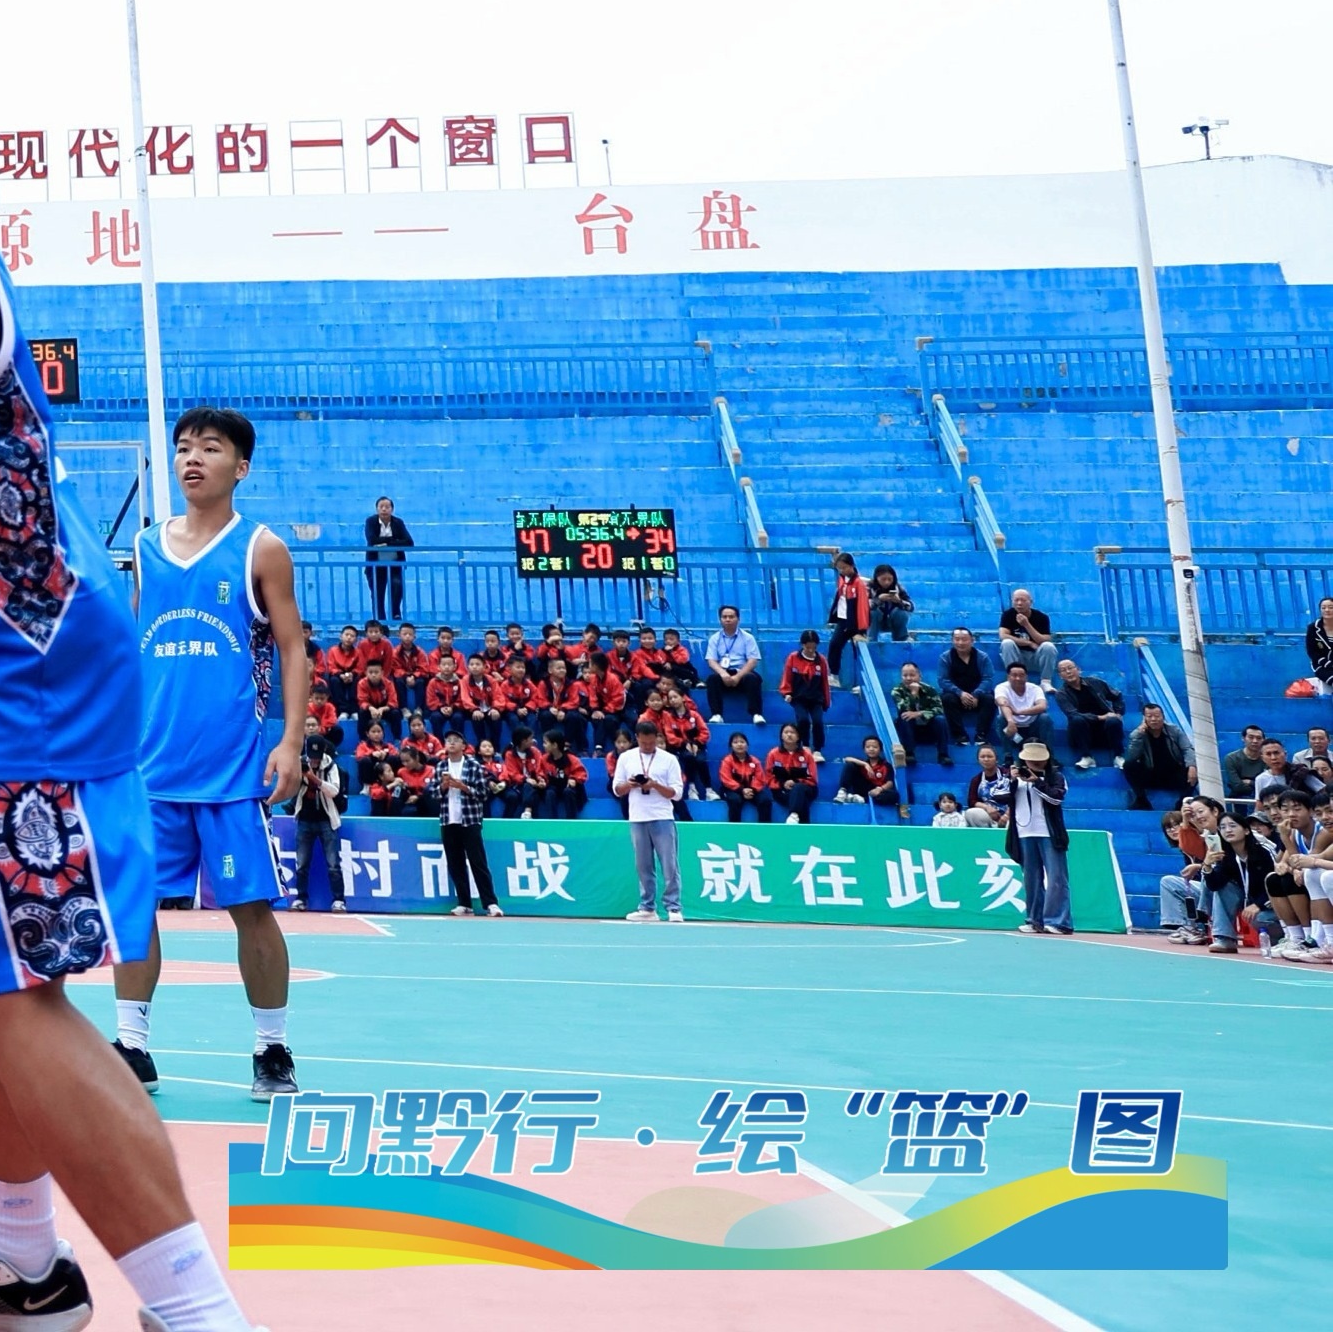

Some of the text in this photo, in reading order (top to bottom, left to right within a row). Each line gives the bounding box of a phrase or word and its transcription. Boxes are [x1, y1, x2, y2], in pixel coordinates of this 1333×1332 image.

[31, 343, 75, 361] 36.4
[520, 527, 675, 555] 47 05:36.4 34
[581, 543, 613, 569] 20
